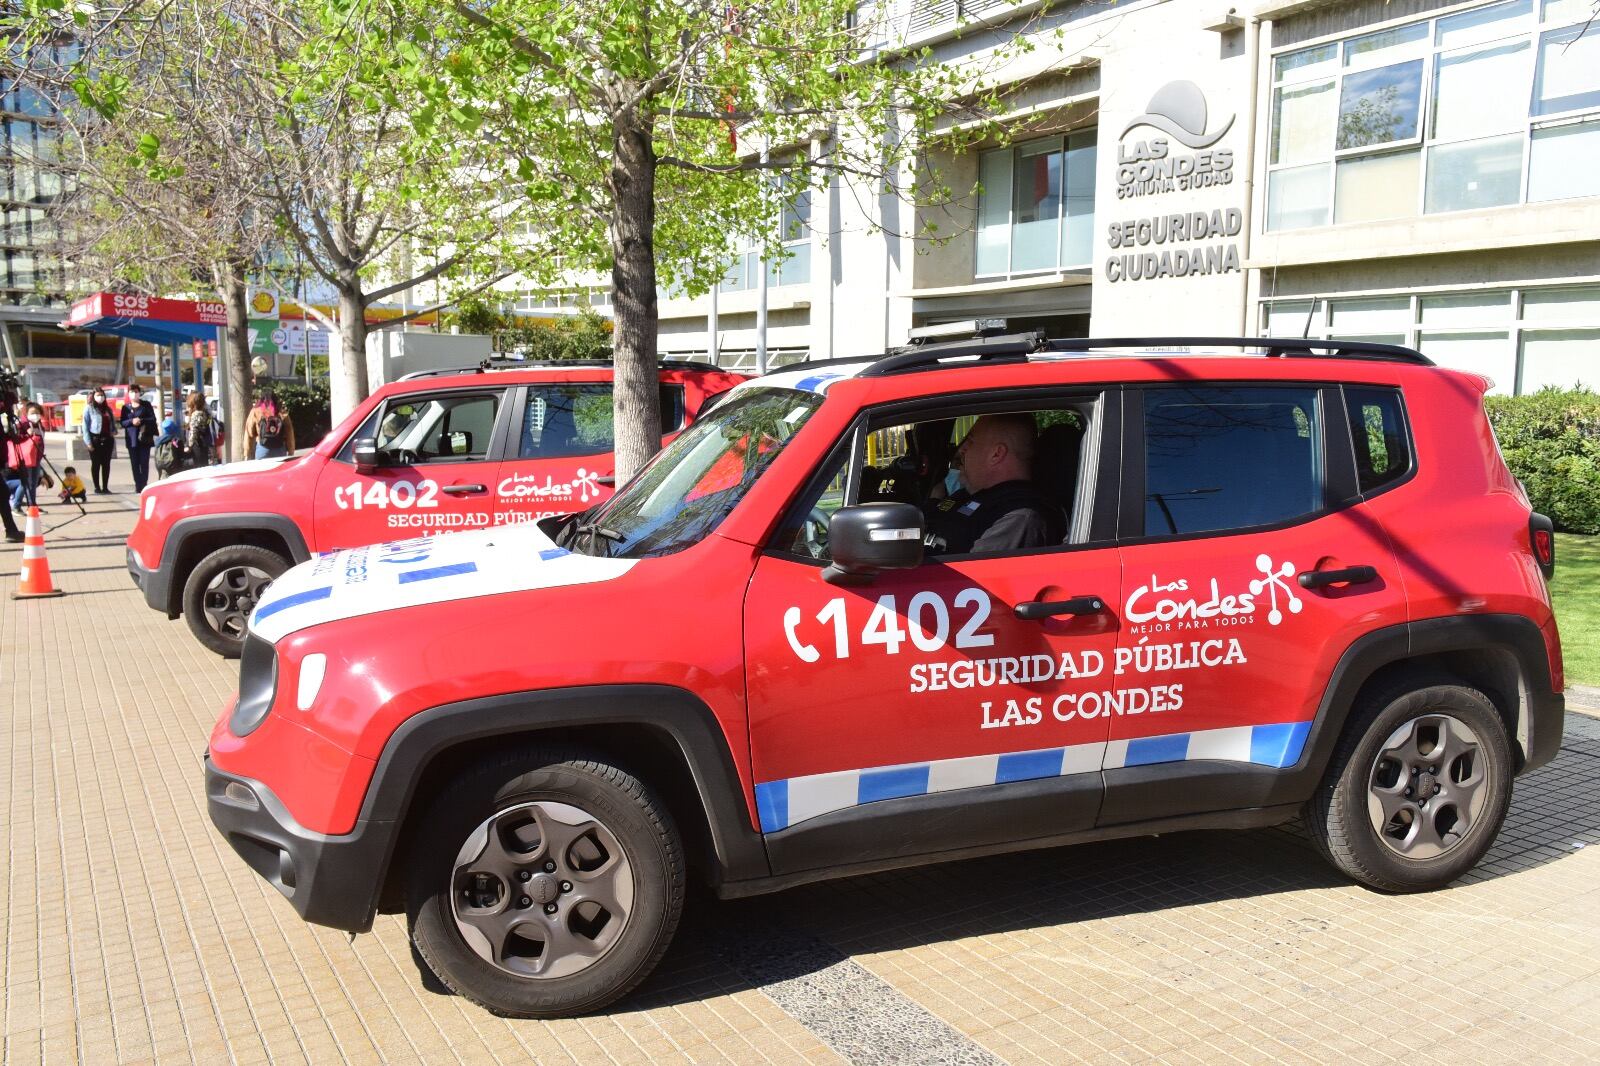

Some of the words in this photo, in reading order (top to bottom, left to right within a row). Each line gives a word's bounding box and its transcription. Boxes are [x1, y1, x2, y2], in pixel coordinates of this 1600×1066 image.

[1117, 138, 1168, 165] LAS
[1116, 148, 1233, 185] CONDES
[1116, 179, 1175, 199] COMUNA
[1179, 170, 1233, 191] CIUDAD
[1107, 207, 1242, 248] SEGURIDAD
[1105, 244, 1241, 283] CIUDADANA
[114, 295, 148, 309] SOS
[115, 308, 149, 317] VECINO
[136, 358, 171, 375] up!
[514, 472, 534, 482] Las
[345, 479, 438, 509] 1402
[498, 475, 572, 496] Condes
[388, 512, 489, 527] SEGURIDAD
[1152, 574, 1188, 592] Las
[1125, 578, 1255, 623] Condes
[816, 588, 994, 659] 1402
[1131, 623, 1171, 634] MEJOR
[1178, 620, 1208, 630] PARA
[1215, 616, 1254, 626] TODOS
[910, 650, 1103, 692] SEGURIDAD
[1114, 637, 1247, 674] PÚBLICA
[980, 697, 1042, 729] LAS
[1053, 684, 1183, 721] CONDES
